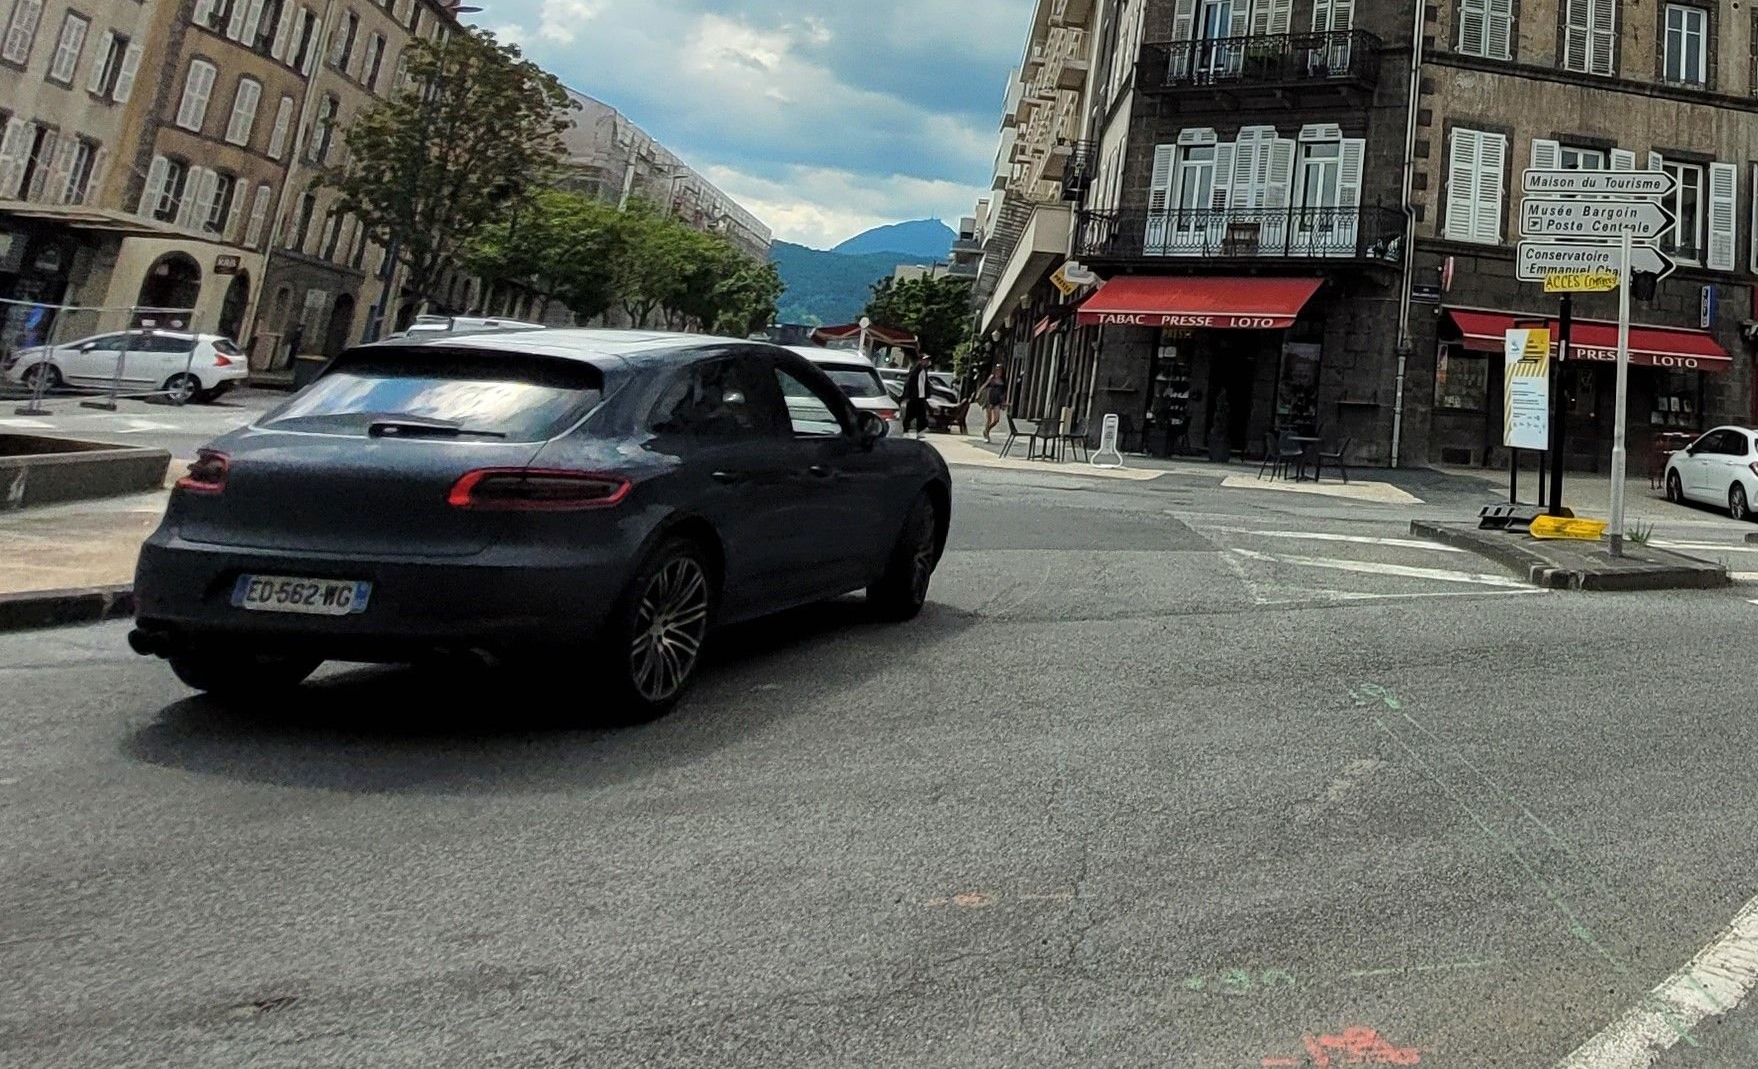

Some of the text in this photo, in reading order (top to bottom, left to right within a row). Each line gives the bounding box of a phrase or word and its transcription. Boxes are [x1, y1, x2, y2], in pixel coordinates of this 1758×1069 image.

[1529, 175, 1661, 190] Maison du Tourisme
[1528, 204, 1638, 220] Musée Bargoin
[1546, 219, 1583, 231] Poste
[1525, 248, 1609, 262] Conservatoire
[1053, 273, 1072, 293] PRESSE
[1097, 313, 1274, 328] TABAC PRESSE LOTO
[1576, 348, 1698, 368] PRESE LOTO
